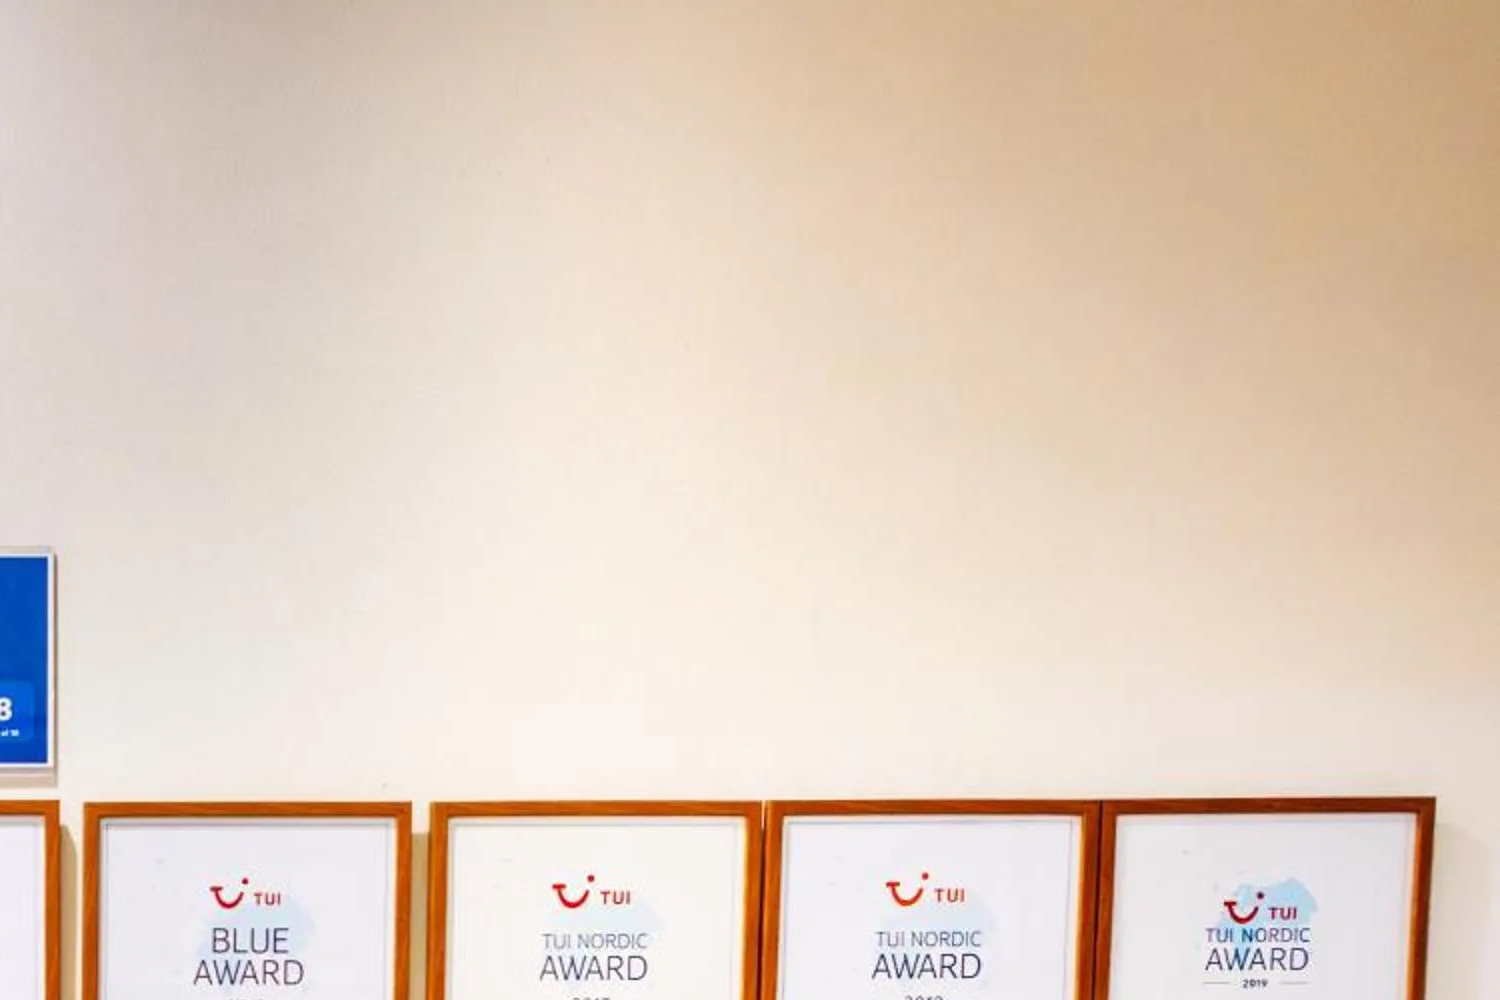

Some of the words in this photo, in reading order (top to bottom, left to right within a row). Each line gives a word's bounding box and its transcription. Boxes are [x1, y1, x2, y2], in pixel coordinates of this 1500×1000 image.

[254, 892, 281, 906] TUI
[600, 890, 631, 905] TUI
[934, 888, 965, 903] TUI
[1268, 907, 1297, 920] TUI
[211, 927, 289, 954] BLUE
[542, 933, 572, 949] TUI
[577, 933, 648, 949] NORDIC
[875, 931, 905, 947] TUI
[911, 931, 982, 947] NORDIC
[1205, 928, 1233, 943] TUI
[1241, 928, 1311, 943] NORDIC
[871, 953, 981, 980] AWARD
[1205, 947, 1309, 971] AWARD
[193, 959, 304, 986] AWARD
[540, 955, 648, 981] AWARD
[1243, 979, 1269, 988] 2019
